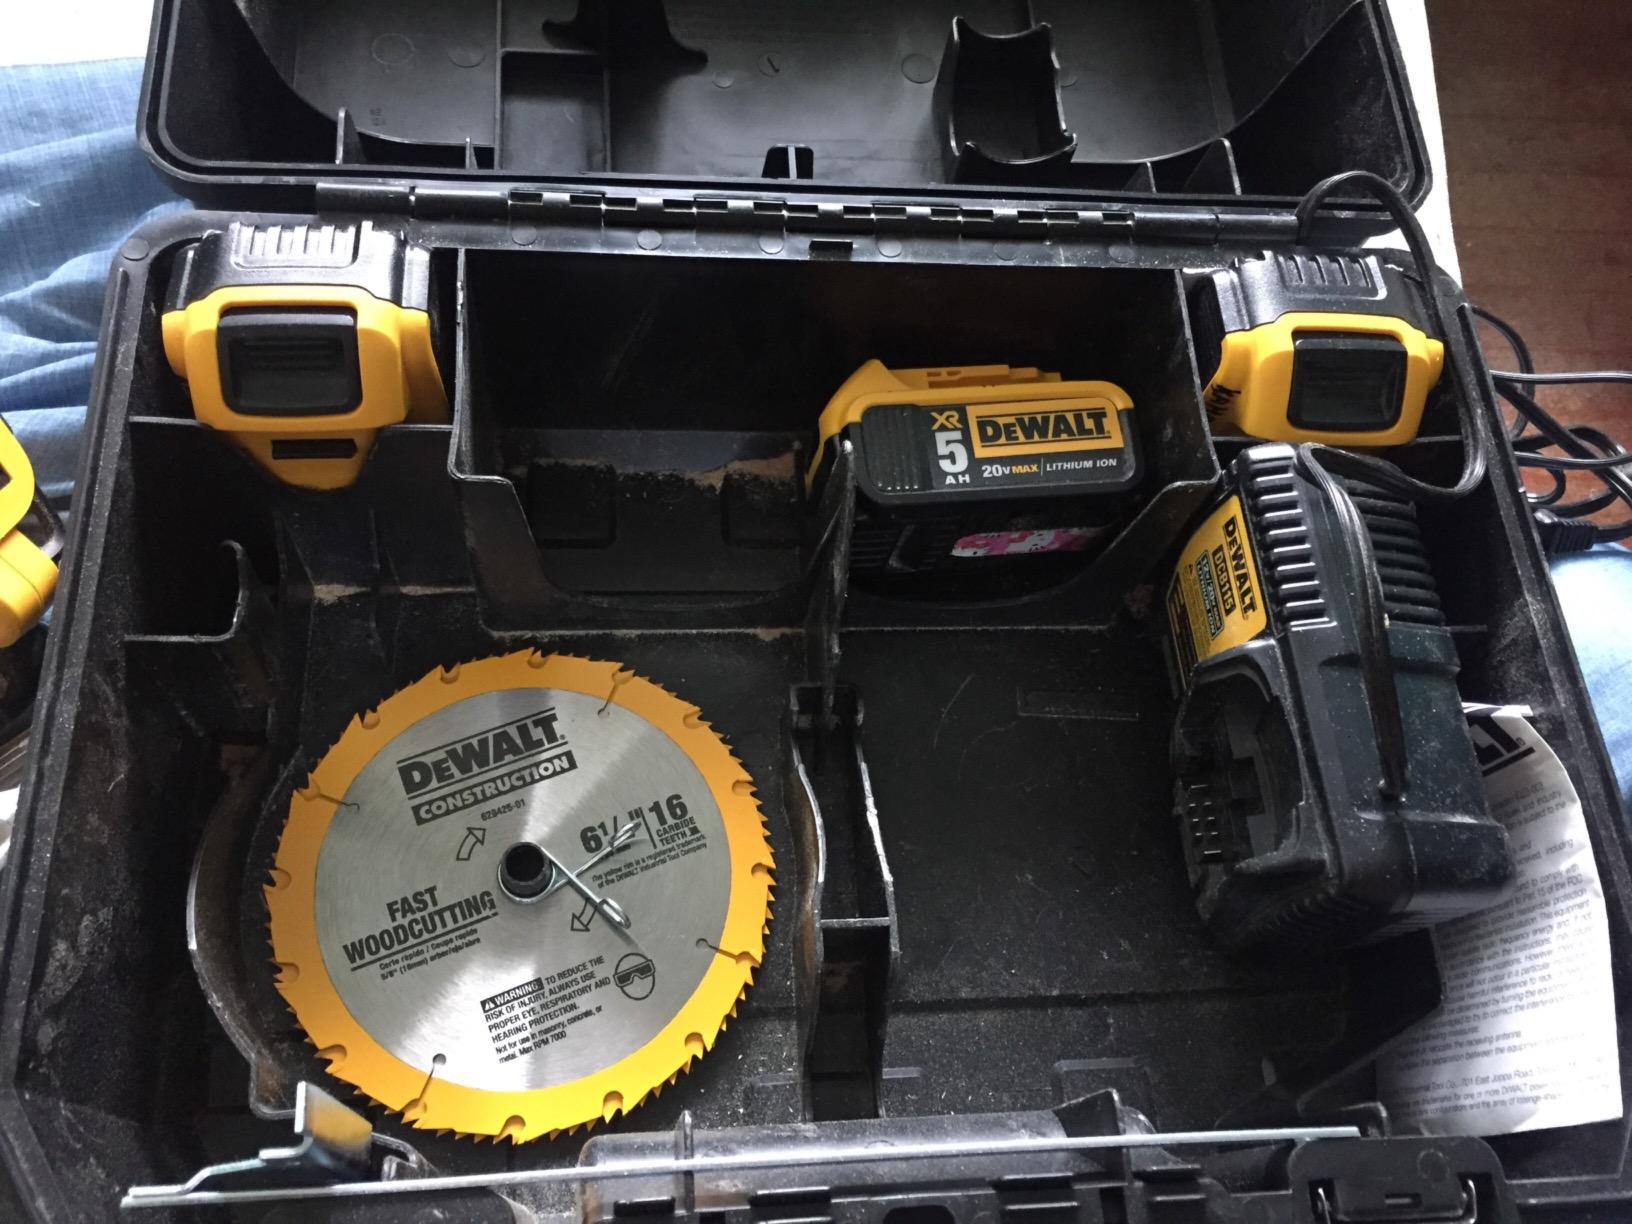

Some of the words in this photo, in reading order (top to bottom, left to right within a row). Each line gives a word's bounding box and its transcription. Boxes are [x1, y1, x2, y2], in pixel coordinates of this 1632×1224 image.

[930, 411, 963, 430] XR
[977, 412, 1107, 443] DEWALT
[935, 431, 968, 473] 5
[1047, 460, 1093, 472] LITHIUM
[1097, 459, 1116, 470] ION
[945, 474, 970, 485] AH
[1214, 549, 1235, 612] DCB115
[1224, 516, 1257, 614] DEWALT
[397, 712, 560, 796] DEWALT
[419, 756, 571, 821] CONSTRUCTION
[648, 794, 689, 826] 16
[655, 815, 696, 839] CARBIDE
[660, 829, 688, 848] TEETH
[386, 885, 438, 923] FAST
[342, 890, 497, 964] WOODCUTTING
[545, 974, 558, 986] TO
[557, 962, 589, 982] REDUCE
[588, 955, 605, 969] THE
[484, 1007, 505, 1023] RISK
[505, 1003, 517, 1015] OF
[547, 977, 580, 998] ALWAYS
[580, 970, 596, 984] USE
[488, 1013, 521, 1034] PROPER
[539, 983, 594, 1014] RESPIRATORY
[593, 976, 612, 991] AND
[491, 1022, 529, 1045] HEARING
[528, 1000, 581, 1030] PROTECTION.
[533, 1036, 551, 1050] RPM
[549, 1029, 568, 1043] 7000
